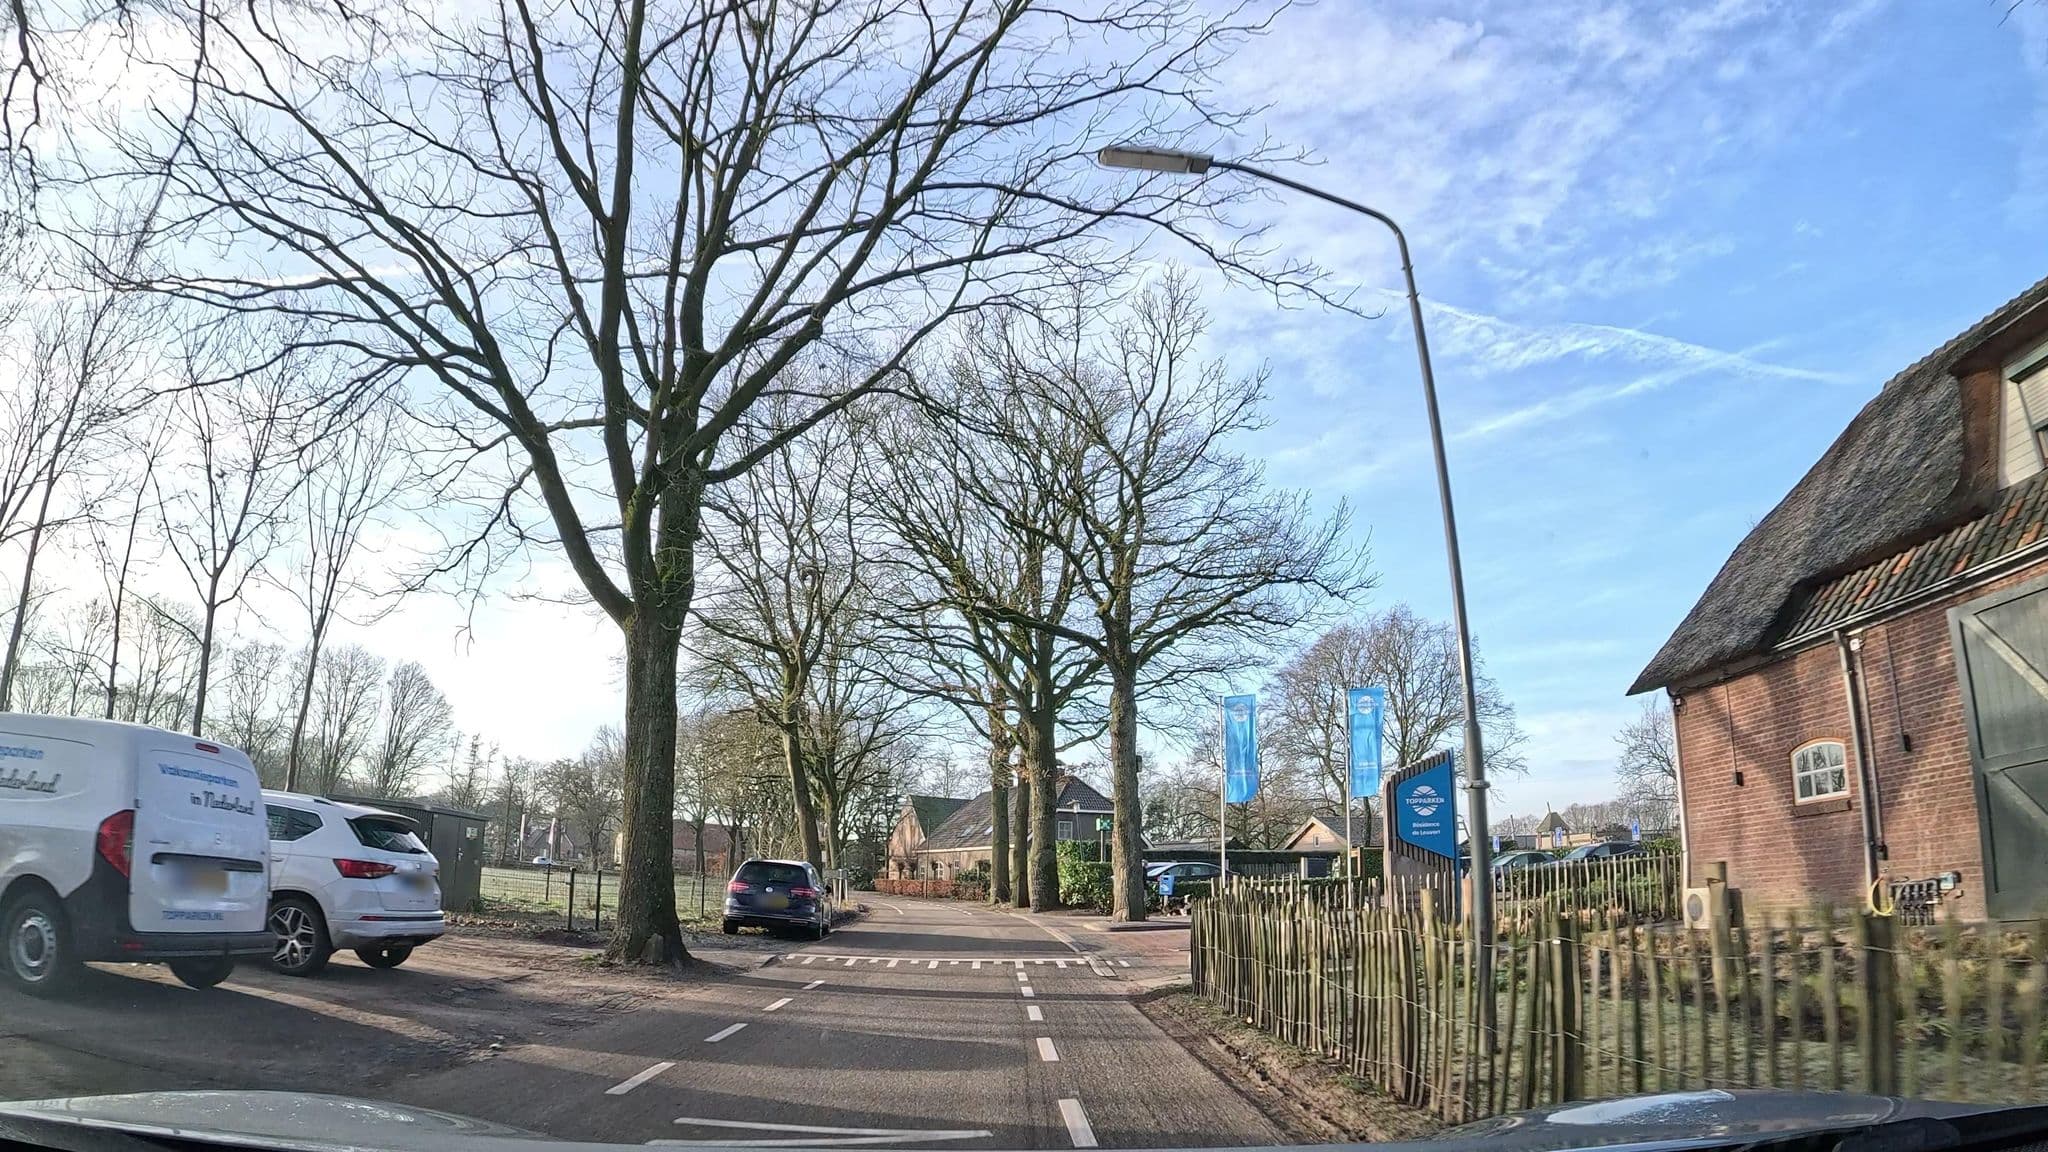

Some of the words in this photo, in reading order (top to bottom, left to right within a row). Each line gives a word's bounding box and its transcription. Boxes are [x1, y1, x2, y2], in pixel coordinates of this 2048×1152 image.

[0, 767, 62, 793] ederland
[190, 791, 202, 806] in
[203, 790, 255, 815] Nederland
[1405, 797, 1445, 805] TOPPARKEN
